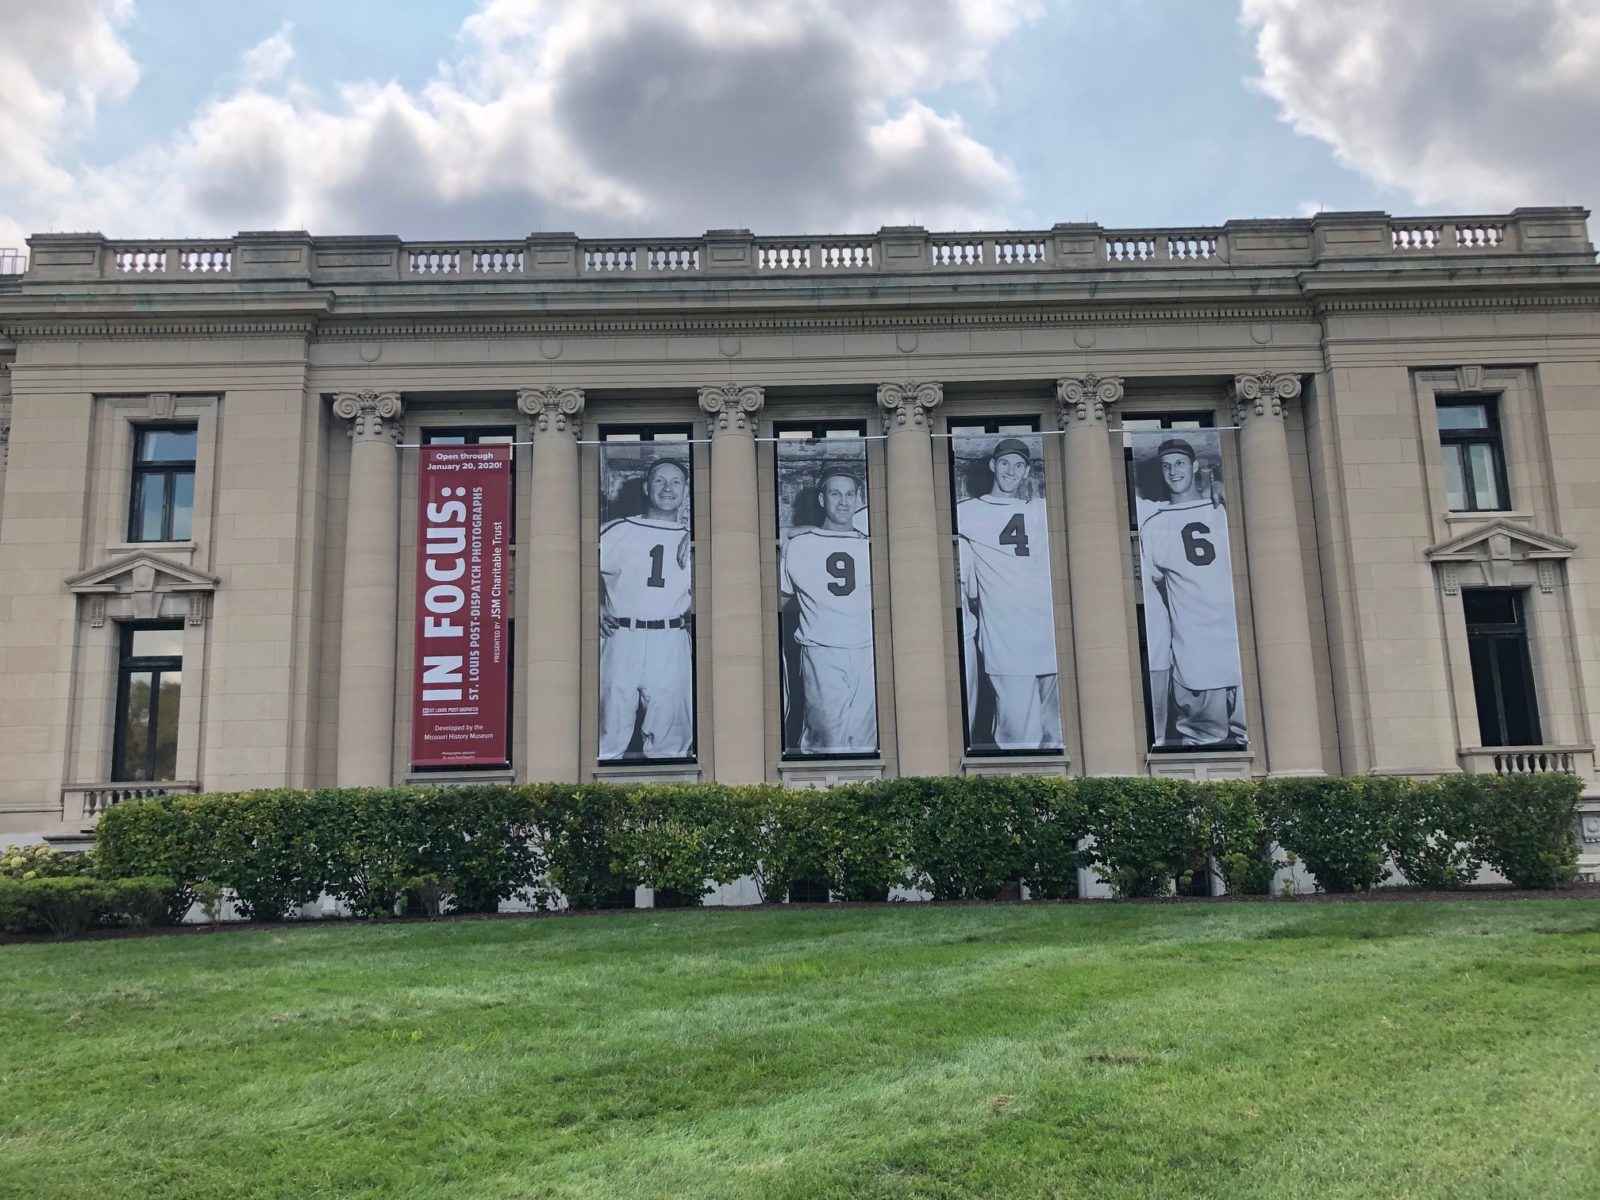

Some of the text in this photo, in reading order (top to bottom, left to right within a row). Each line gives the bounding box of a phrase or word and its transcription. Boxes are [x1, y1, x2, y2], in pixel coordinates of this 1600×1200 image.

[427, 463, 461, 471] January
[436, 452, 494, 461] Open through
[492, 521, 502, 546] Trust
[999, 513, 1030, 557] 4
[1181, 521, 1216, 567] 6
[424, 486, 467, 638] FOCUS:
[491, 545, 502, 597] Charitable
[646, 543, 665, 588] 1
[826, 551, 856, 597] 9
[469, 486, 483, 700] ST. LOUIS POST-DISPATCH PHOTOGRAPHS
[491, 599, 501, 619] JSM
[494, 621, 501, 630] BY
[422, 655, 463, 701] IN
[434, 724, 465, 732] Developed
[466, 724, 474, 732] by
